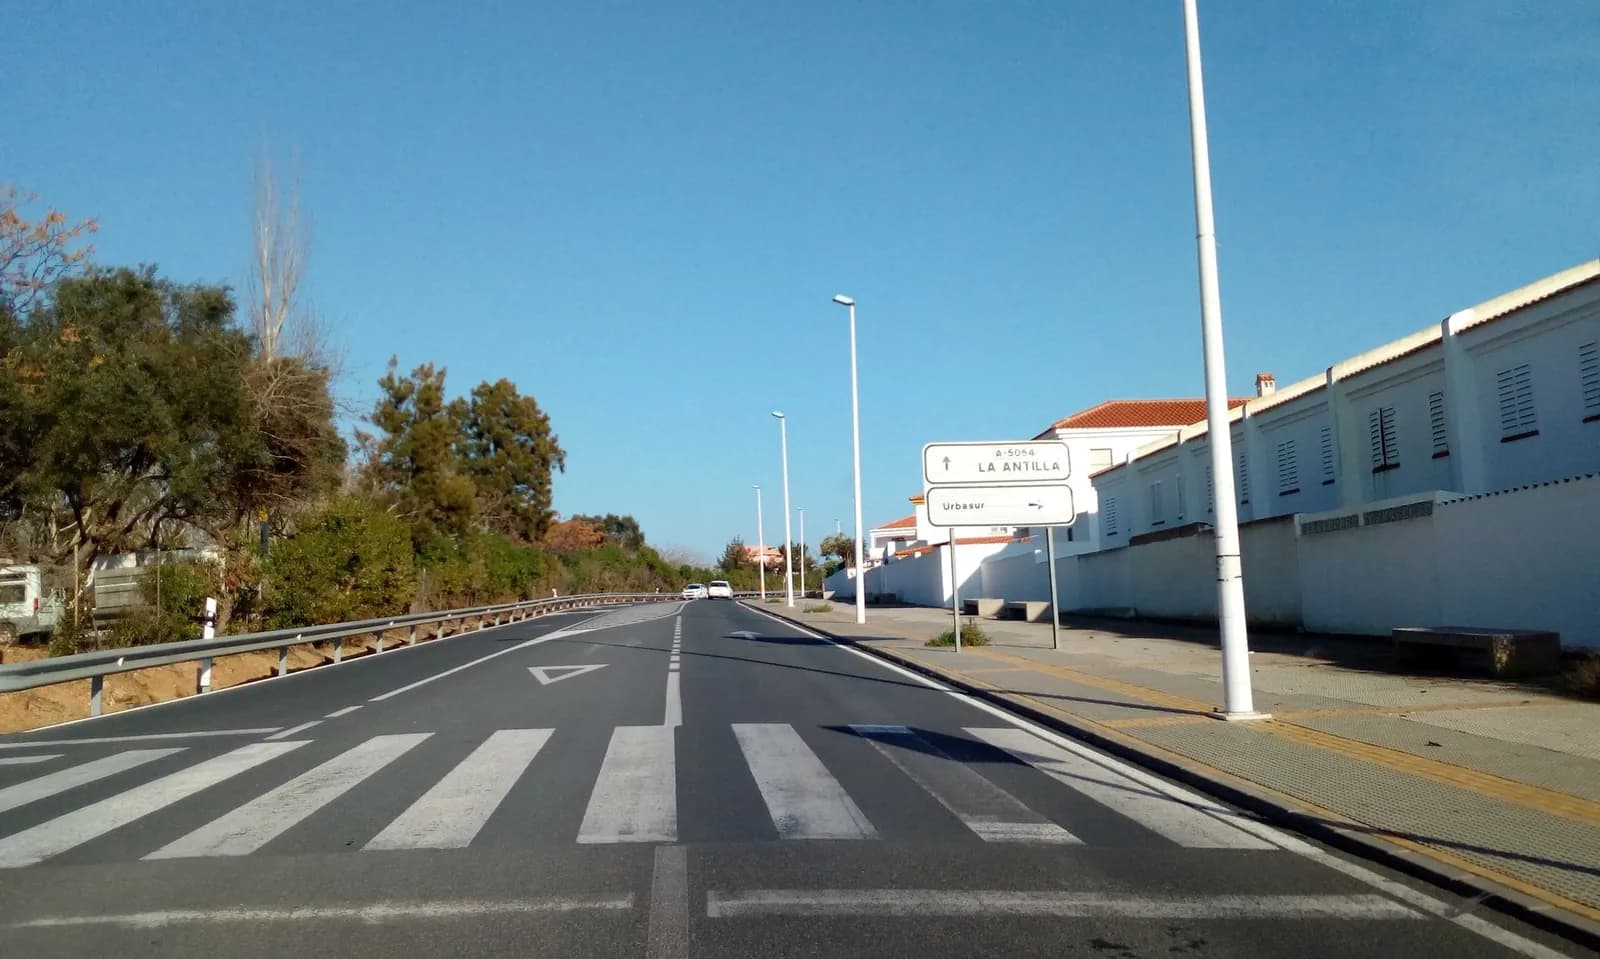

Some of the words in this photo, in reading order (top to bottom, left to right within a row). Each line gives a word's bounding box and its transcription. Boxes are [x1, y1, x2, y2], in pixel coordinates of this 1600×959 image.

[978, 462, 996, 473] LA
[1003, 461, 1061, 472] ANTILLA
[943, 502, 985, 511] Urbasur
